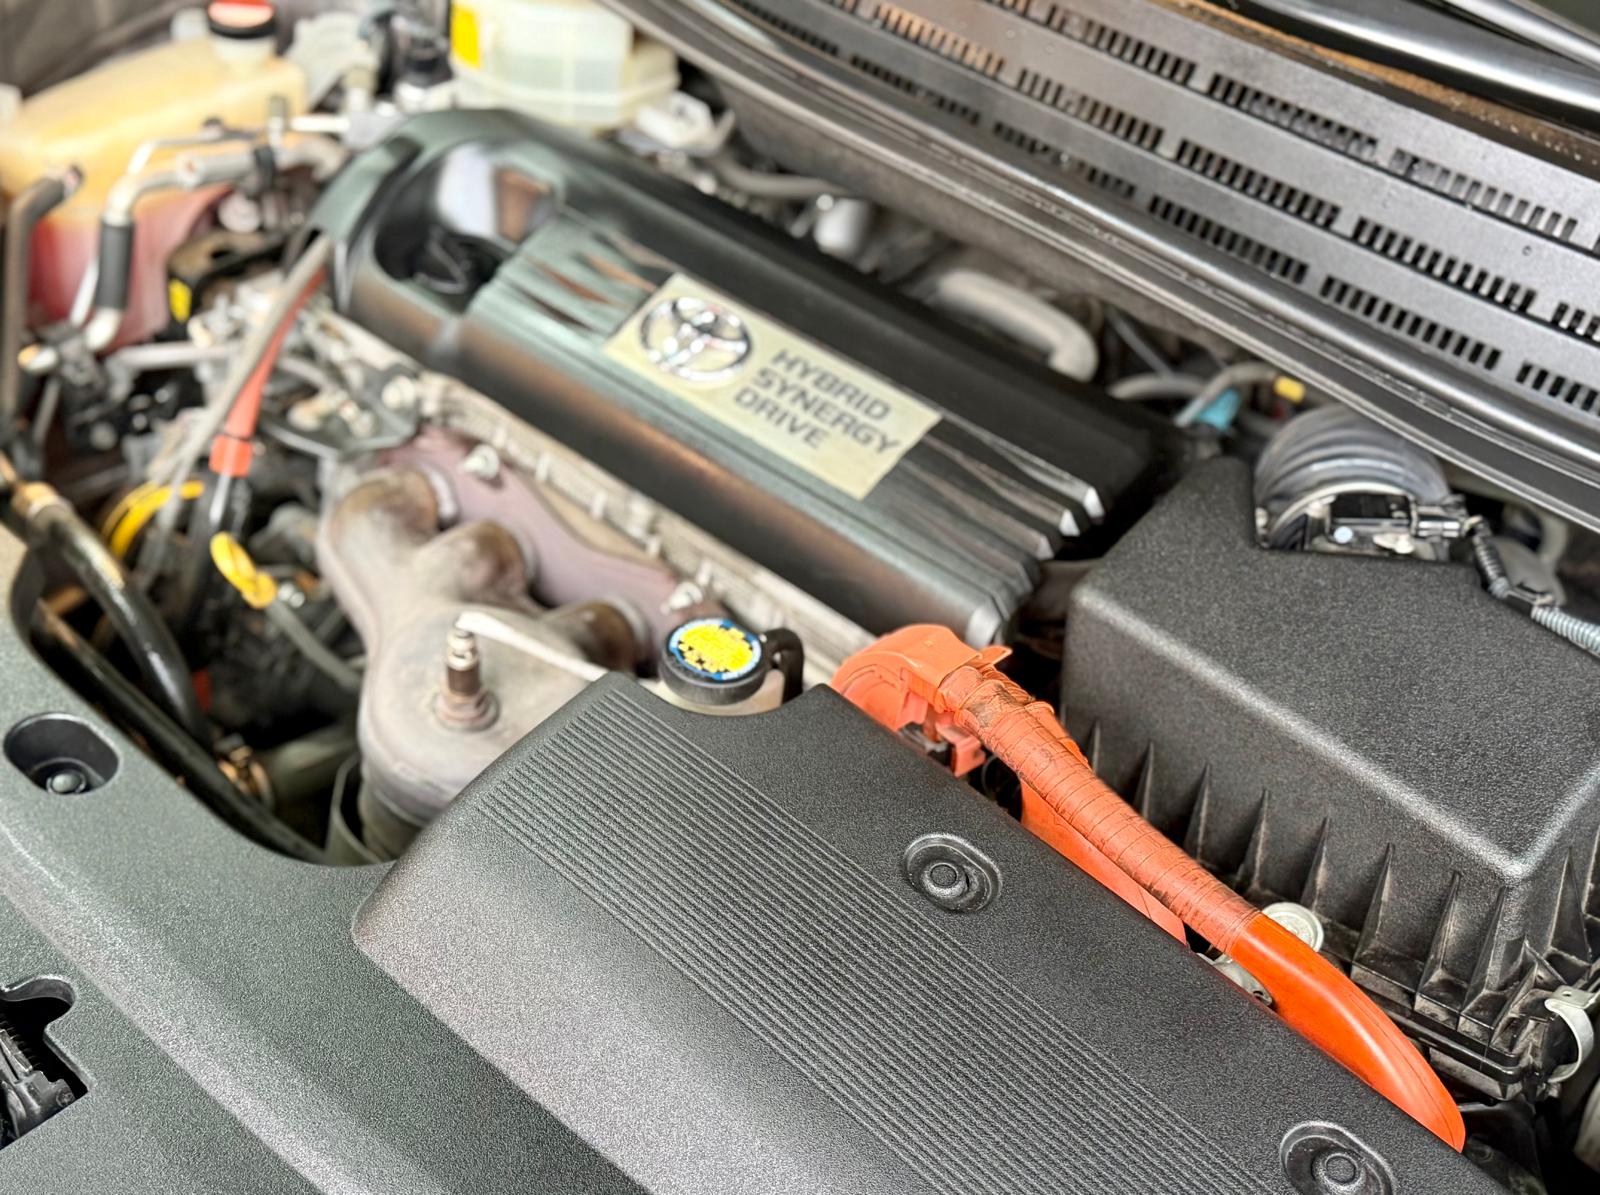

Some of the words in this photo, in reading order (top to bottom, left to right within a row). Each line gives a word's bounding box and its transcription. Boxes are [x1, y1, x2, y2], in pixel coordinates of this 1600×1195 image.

[735, 387, 830, 448] DRIVE
[753, 368, 900, 453] SYNERGY
[772, 350, 890, 420] HYBRID
